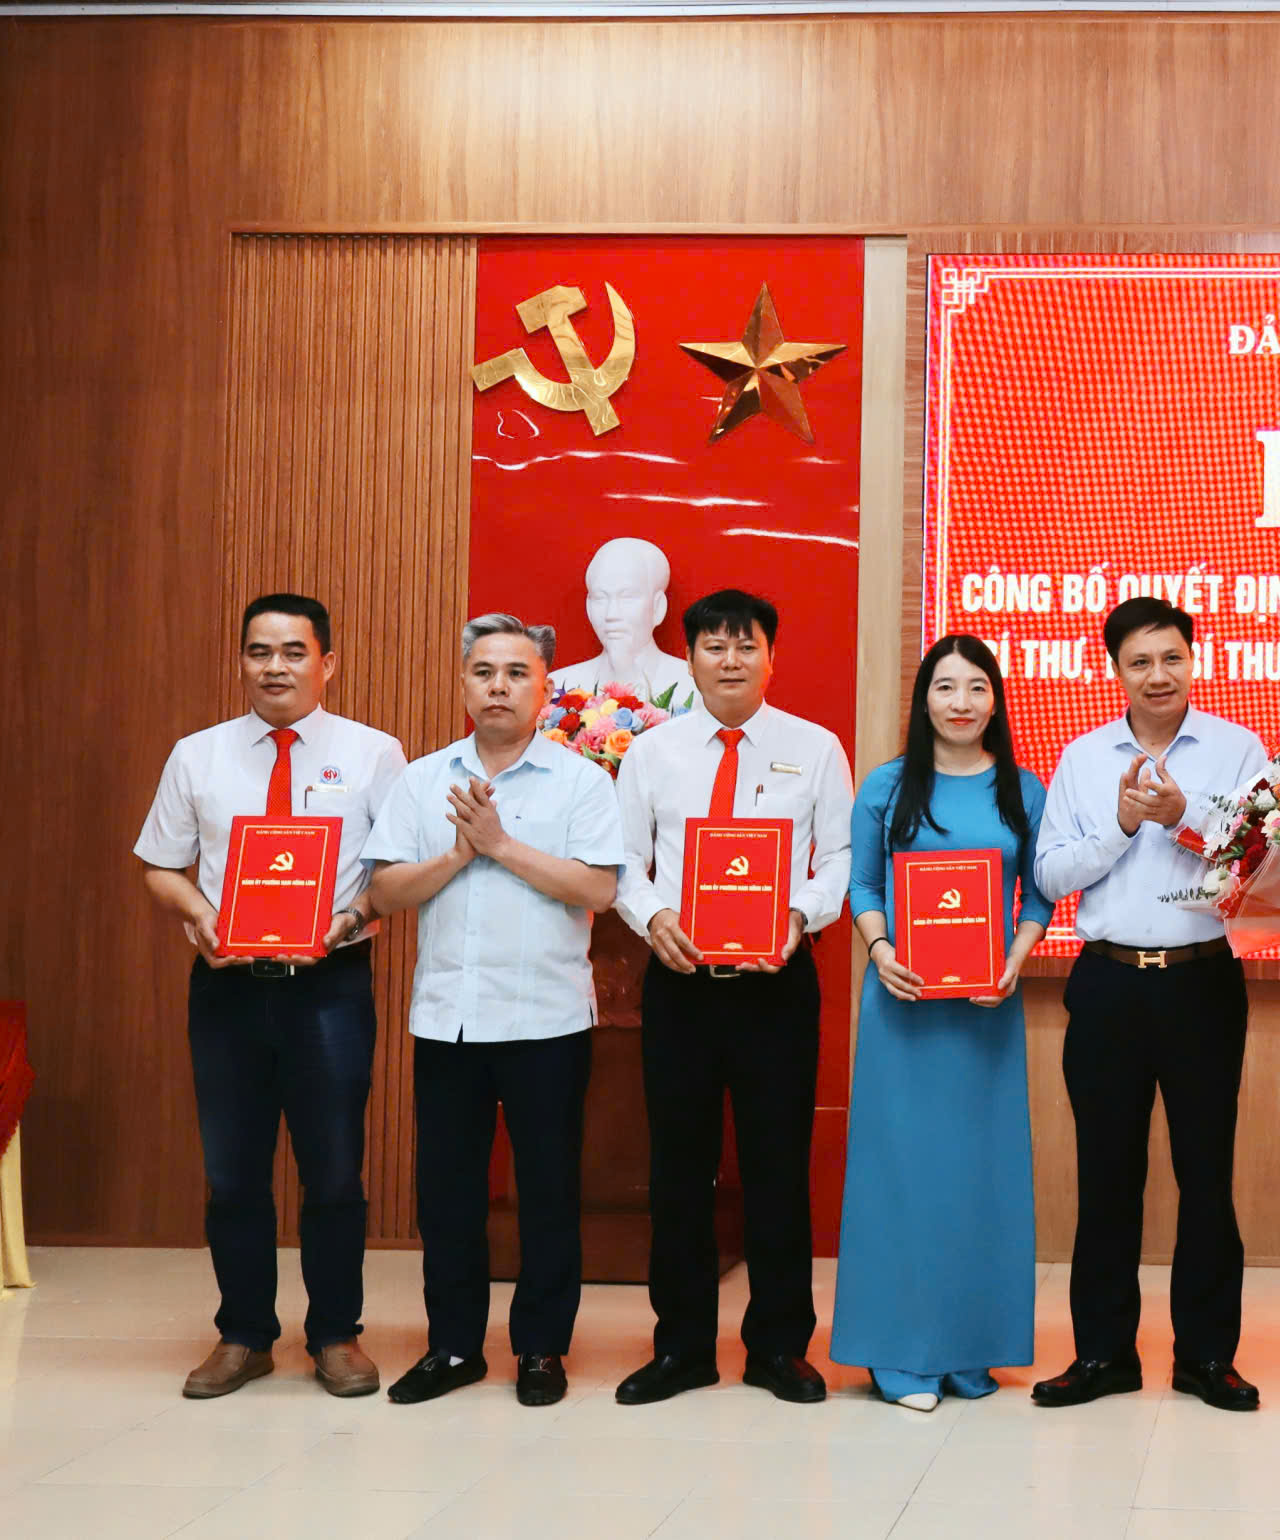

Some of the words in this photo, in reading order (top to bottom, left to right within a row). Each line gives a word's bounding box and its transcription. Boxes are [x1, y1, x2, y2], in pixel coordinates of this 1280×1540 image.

[962, 566, 1051, 612] CÔNG
[1063, 562, 1109, 613] BỐ
[1119, 563, 1223, 613] QUYẾT
[1020, 637, 1093, 684] THƯ,
